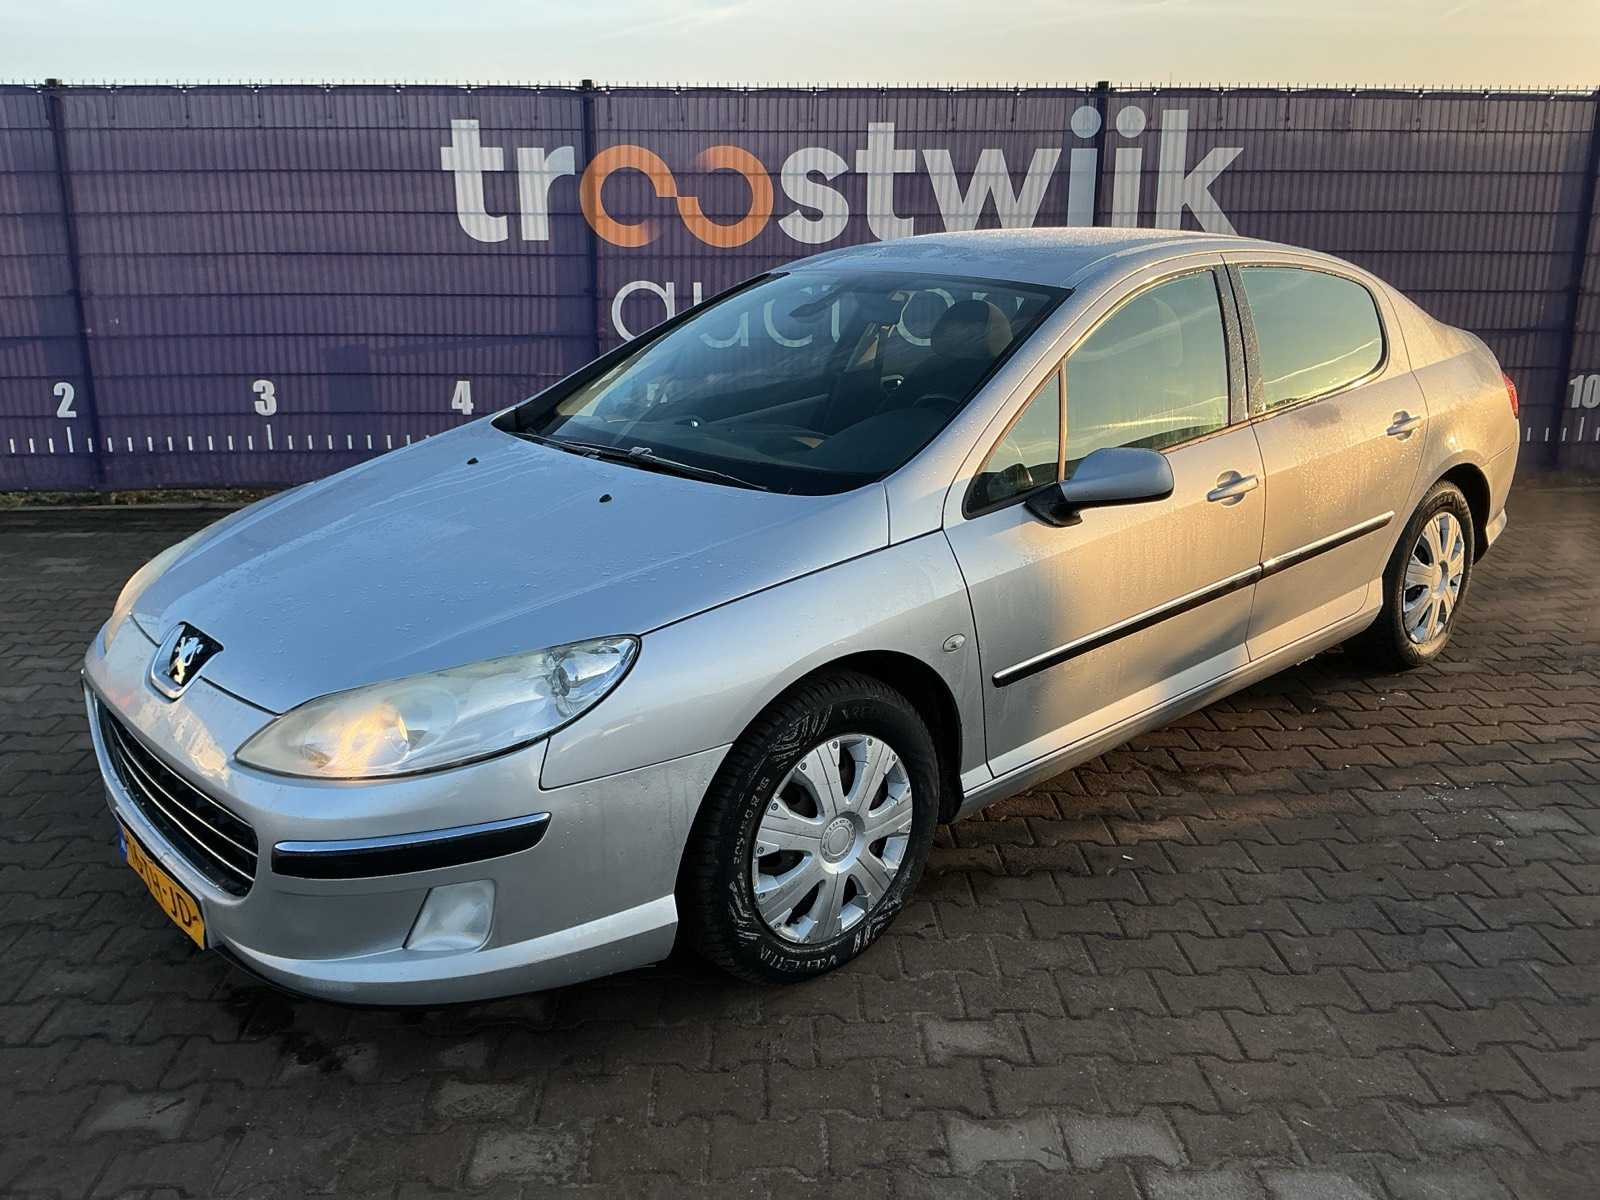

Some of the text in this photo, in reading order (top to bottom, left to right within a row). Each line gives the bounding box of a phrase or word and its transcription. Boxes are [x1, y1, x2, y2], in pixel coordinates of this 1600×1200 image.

[53, 381, 77, 418] 2
[252, 379, 278, 416] 3
[450, 380, 474, 415] 4
[1569, 374, 1600, 408] 10
